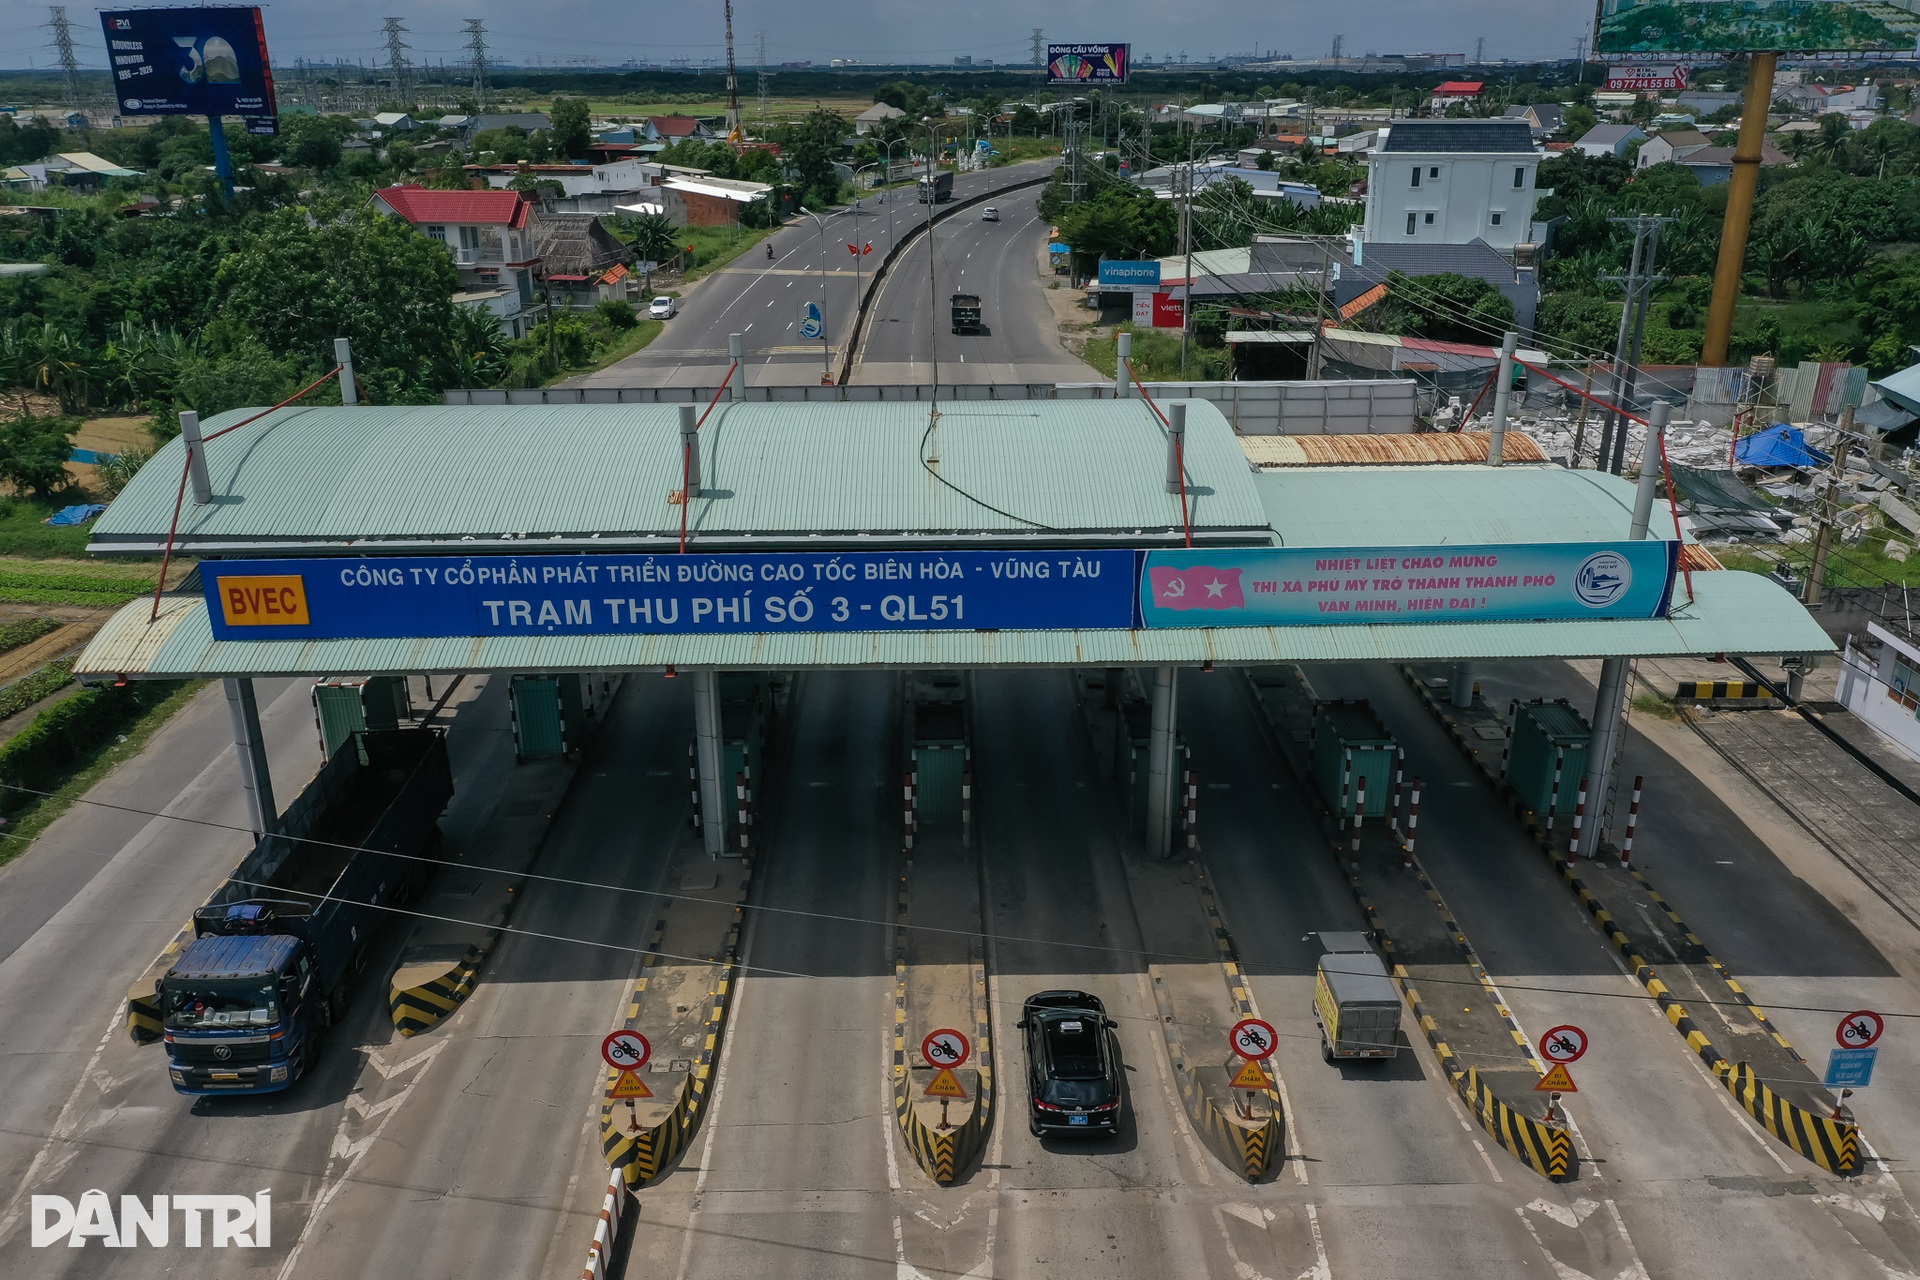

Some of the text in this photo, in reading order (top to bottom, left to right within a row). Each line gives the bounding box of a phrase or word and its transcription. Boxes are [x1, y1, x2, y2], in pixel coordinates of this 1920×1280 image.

[1610, 79, 1676, 89] 09 77 44 55 88
[1104, 266, 1155, 278] vinaphone
[340, 565, 404, 586] CÔNG
[410, 567, 438, 585] TY
[444, 559, 475, 586] CỔ
[478, 559, 538, 584] PHẦN
[542, 562, 599, 583] PHÁT
[606, 557, 670, 583] TRIỂN
[677, 559, 754, 583] ĐƯỜNG
[760, 564, 805, 581] CAO
[813, 556, 857, 581] TỐC
[864, 558, 912, 580] BIÊN
[920, 557, 964, 579] HÒA
[991, 557, 1050, 579] VŨNG
[1058, 557, 1101, 578] TÀU
[228, 587, 298, 615] BVEC
[483, 599, 593, 631] TRẠM
[603, 598, 679, 624] THU
[692, 589, 753, 623] PHÍ
[764, 586, 814, 623] SỐ
[831, 596, 850, 622] 3
[880, 594, 963, 622] QL51
[1354, 600, 1402, 613] MINH,
